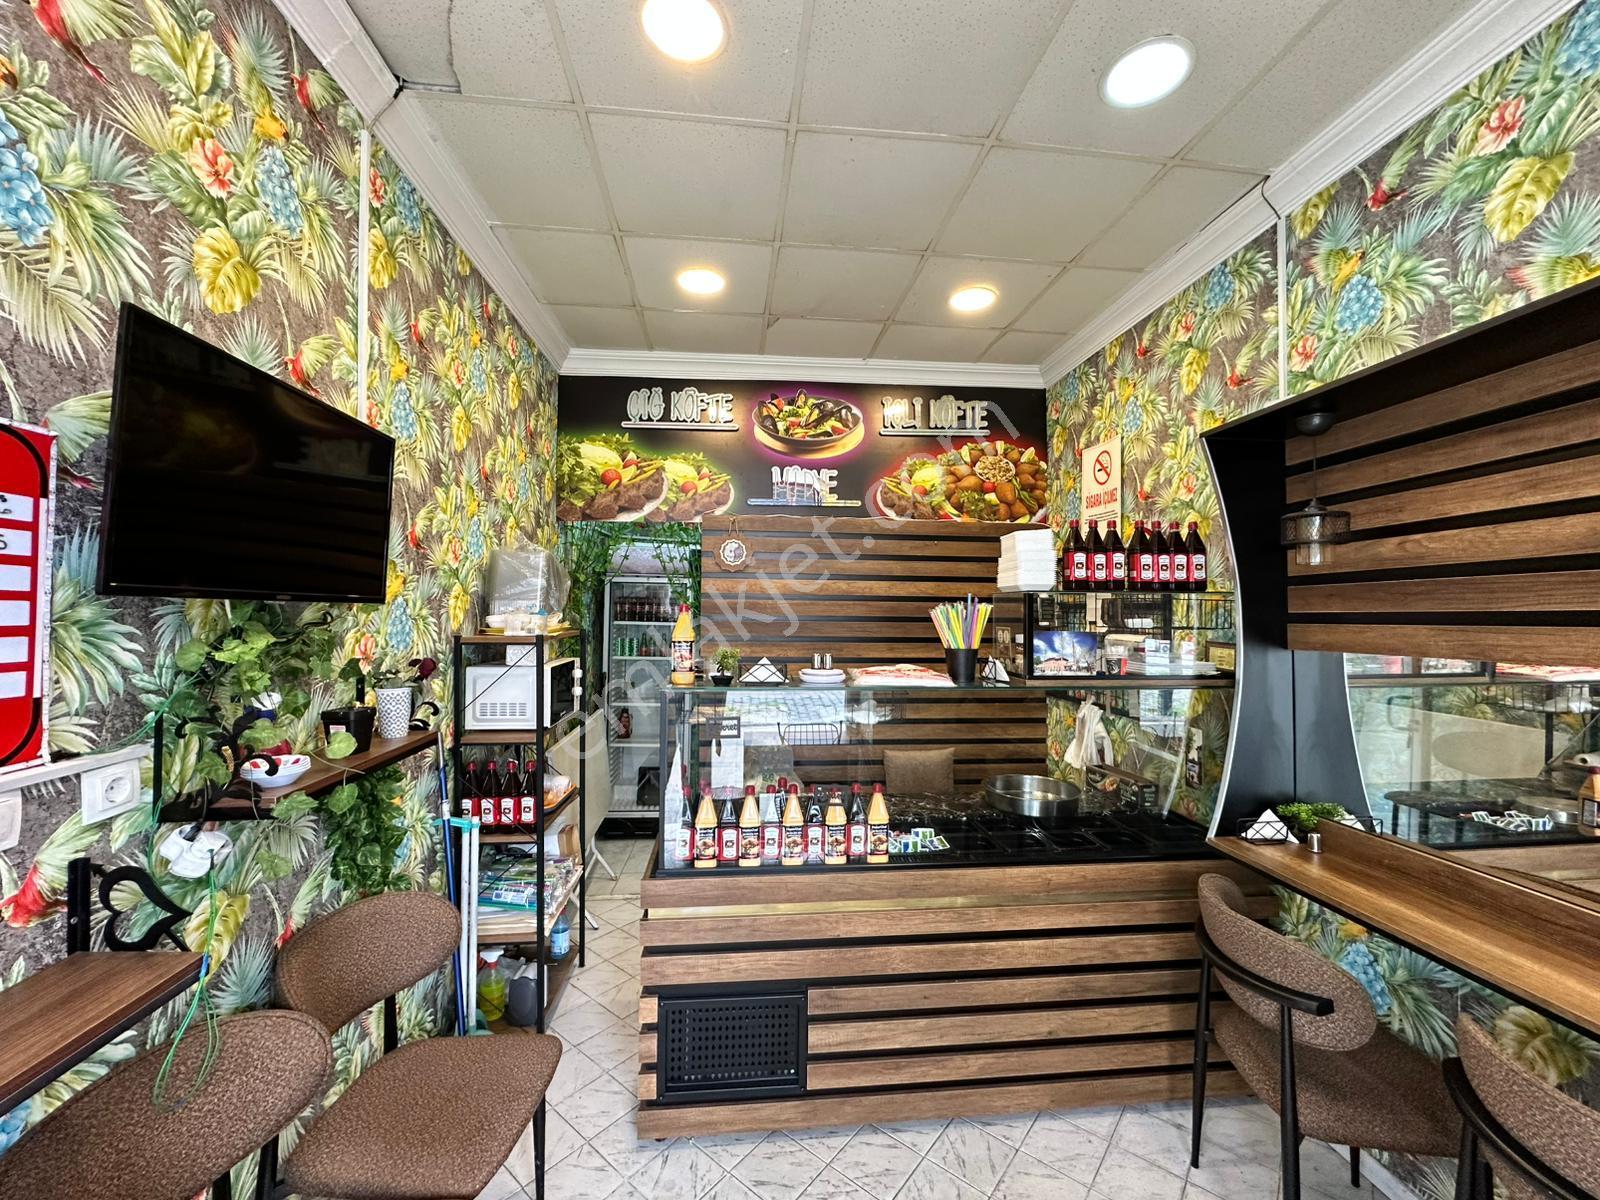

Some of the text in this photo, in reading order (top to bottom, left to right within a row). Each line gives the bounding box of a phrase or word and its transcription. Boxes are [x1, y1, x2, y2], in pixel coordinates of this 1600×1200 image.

[627, 387, 733, 423] ÇİĞ KÖFTE
[929, 395, 988, 429] KÖFTE
